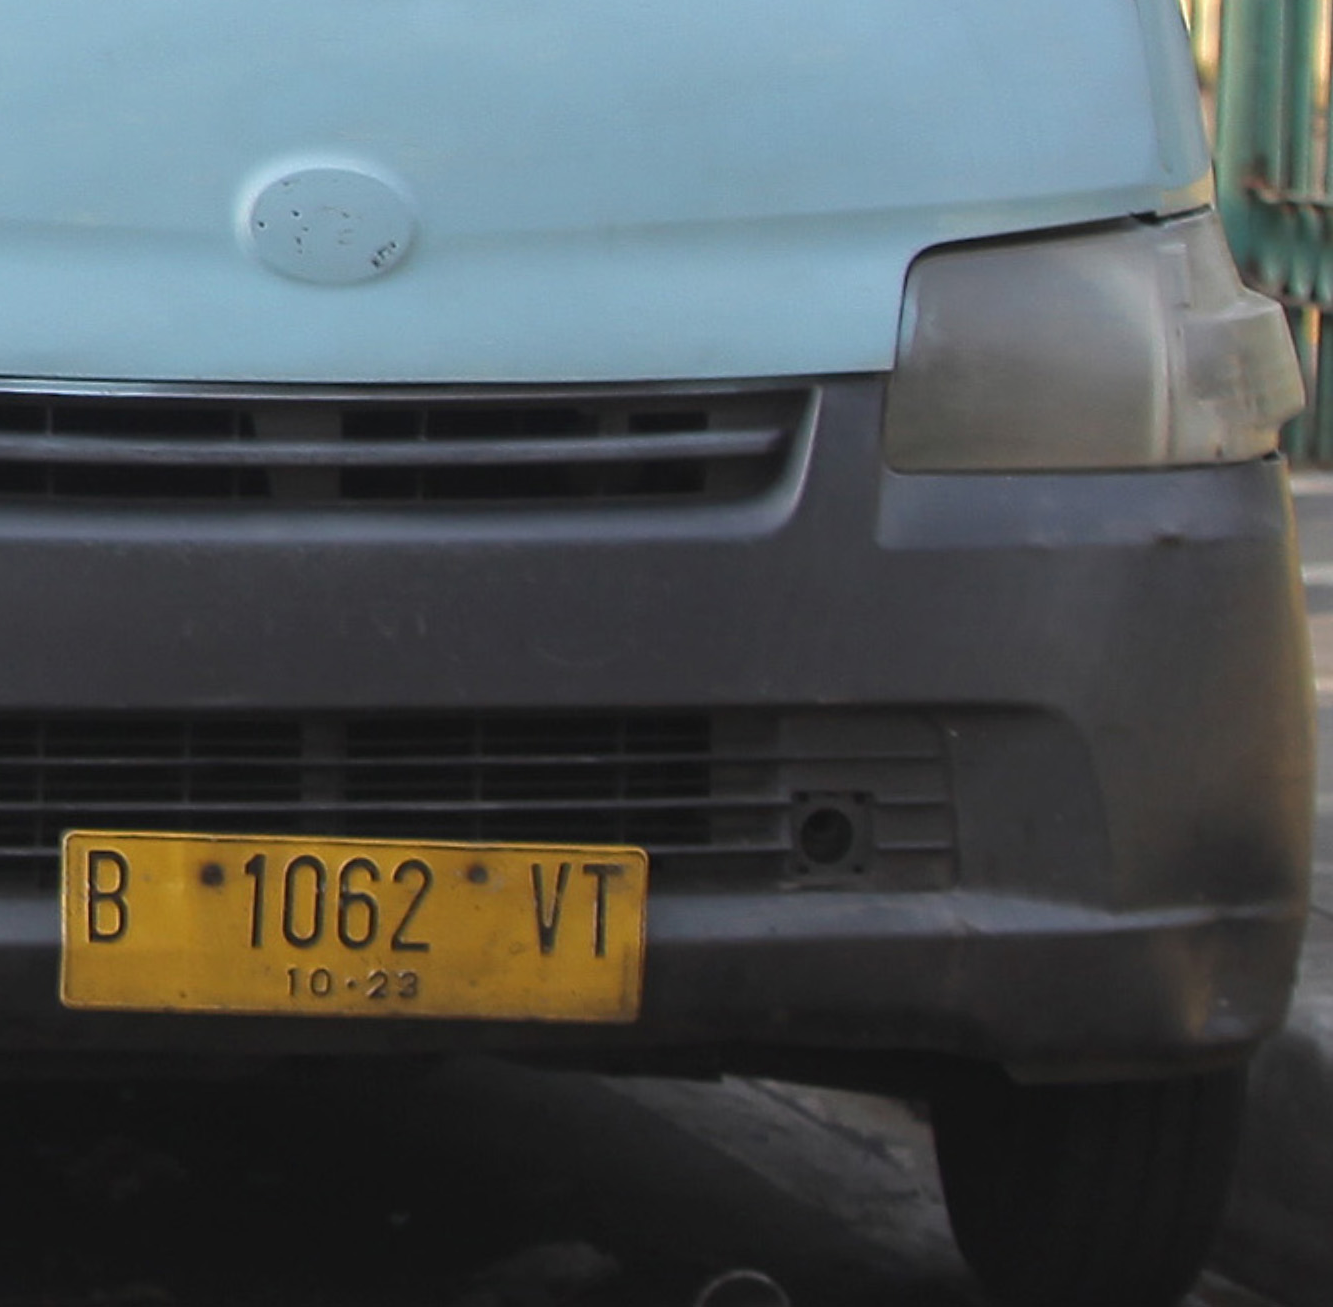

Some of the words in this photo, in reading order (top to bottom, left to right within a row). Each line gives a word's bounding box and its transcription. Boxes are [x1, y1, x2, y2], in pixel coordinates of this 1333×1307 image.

[86, 848, 130, 944] B
[243, 852, 435, 953] 1062
[530, 861, 626, 958] VT
